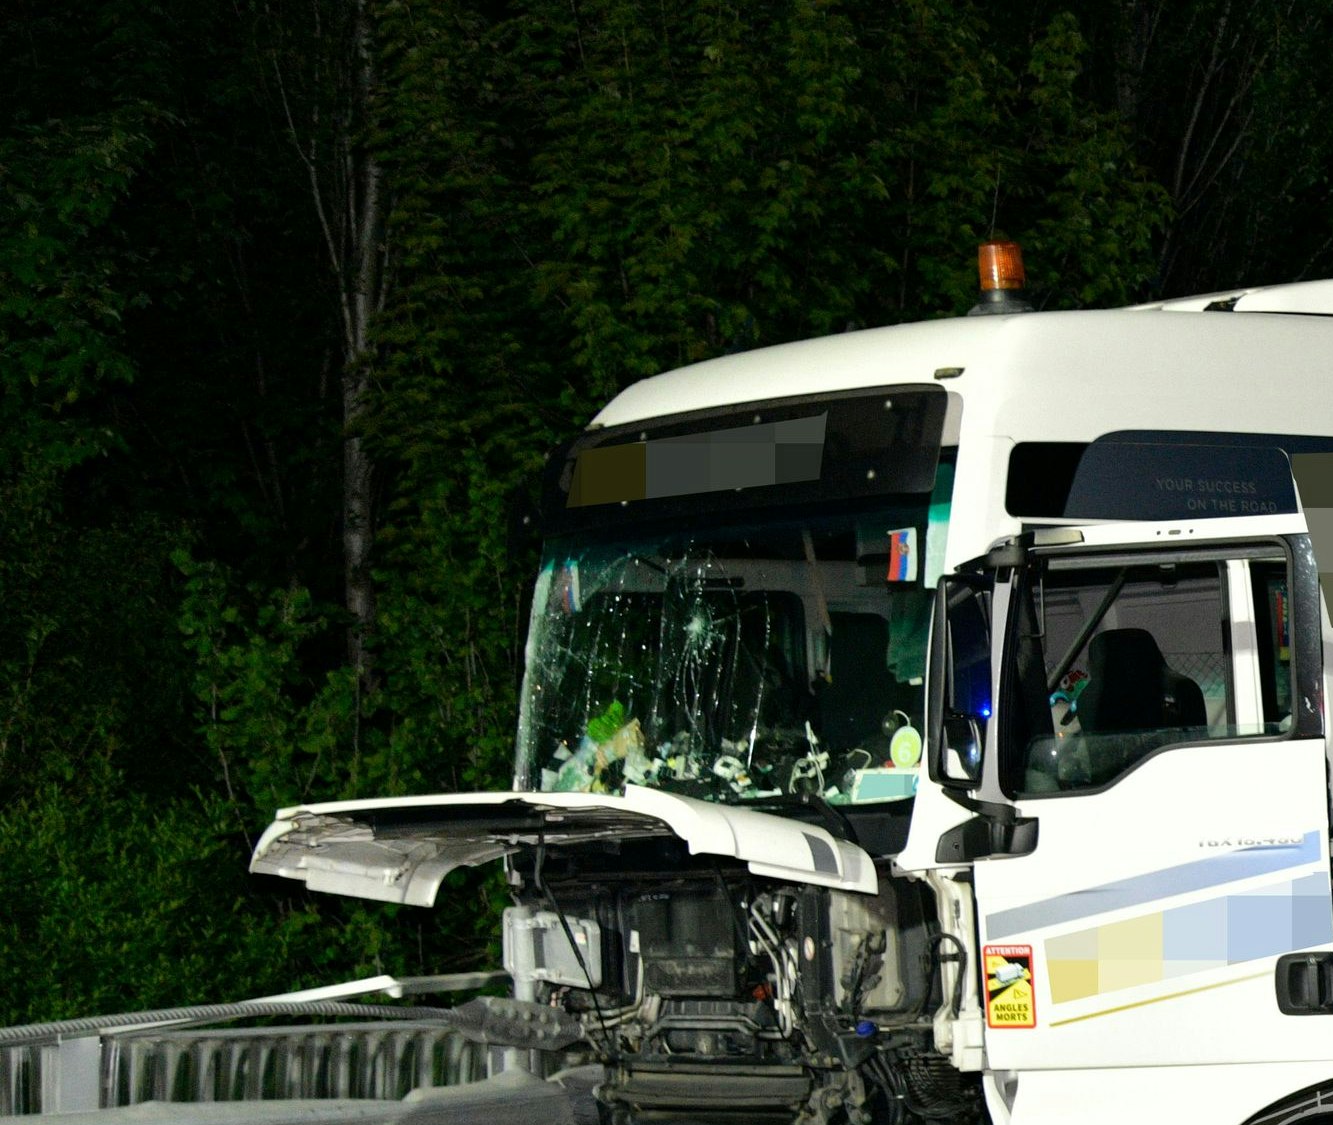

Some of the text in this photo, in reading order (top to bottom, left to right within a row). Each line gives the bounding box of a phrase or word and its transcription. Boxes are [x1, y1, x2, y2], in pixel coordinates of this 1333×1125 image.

[1156, 480, 1257, 494] YOUR SUCCESS
[1187, 500, 1278, 513] ON THE ROAD
[985, 946, 1030, 955] ATTENTION
[994, 1004, 1028, 1012] ANGLES
[996, 1013, 1028, 1021] MORTS
